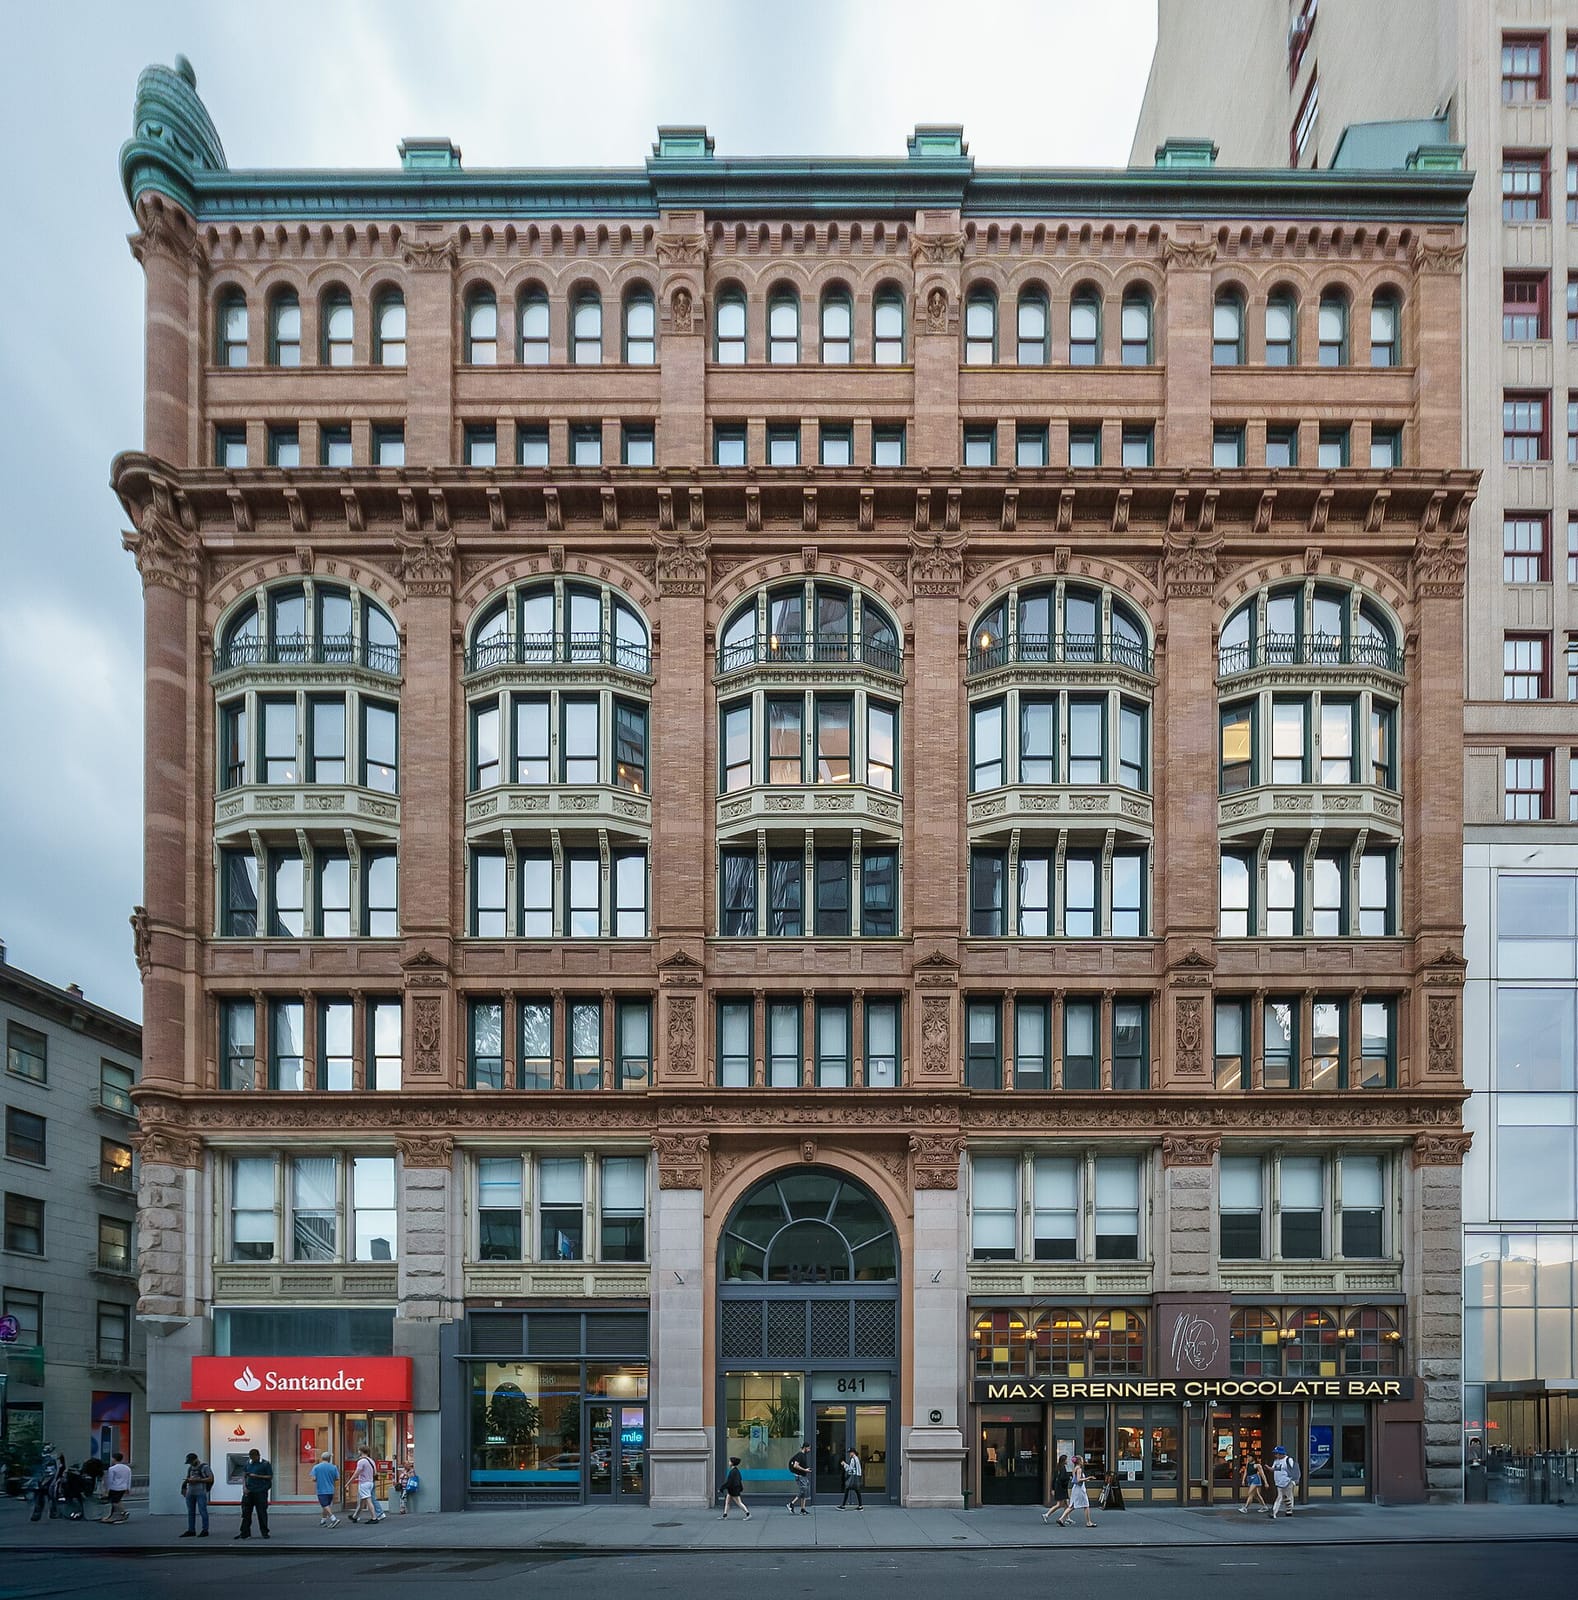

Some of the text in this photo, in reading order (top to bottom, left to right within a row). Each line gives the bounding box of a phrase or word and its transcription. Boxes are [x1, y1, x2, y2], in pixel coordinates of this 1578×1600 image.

[265, 1370, 365, 1391] Santander
[837, 1377, 865, 1393] 841
[988, 1381, 1401, 1398] MAX BRENNER CHOCOLATE BAR
